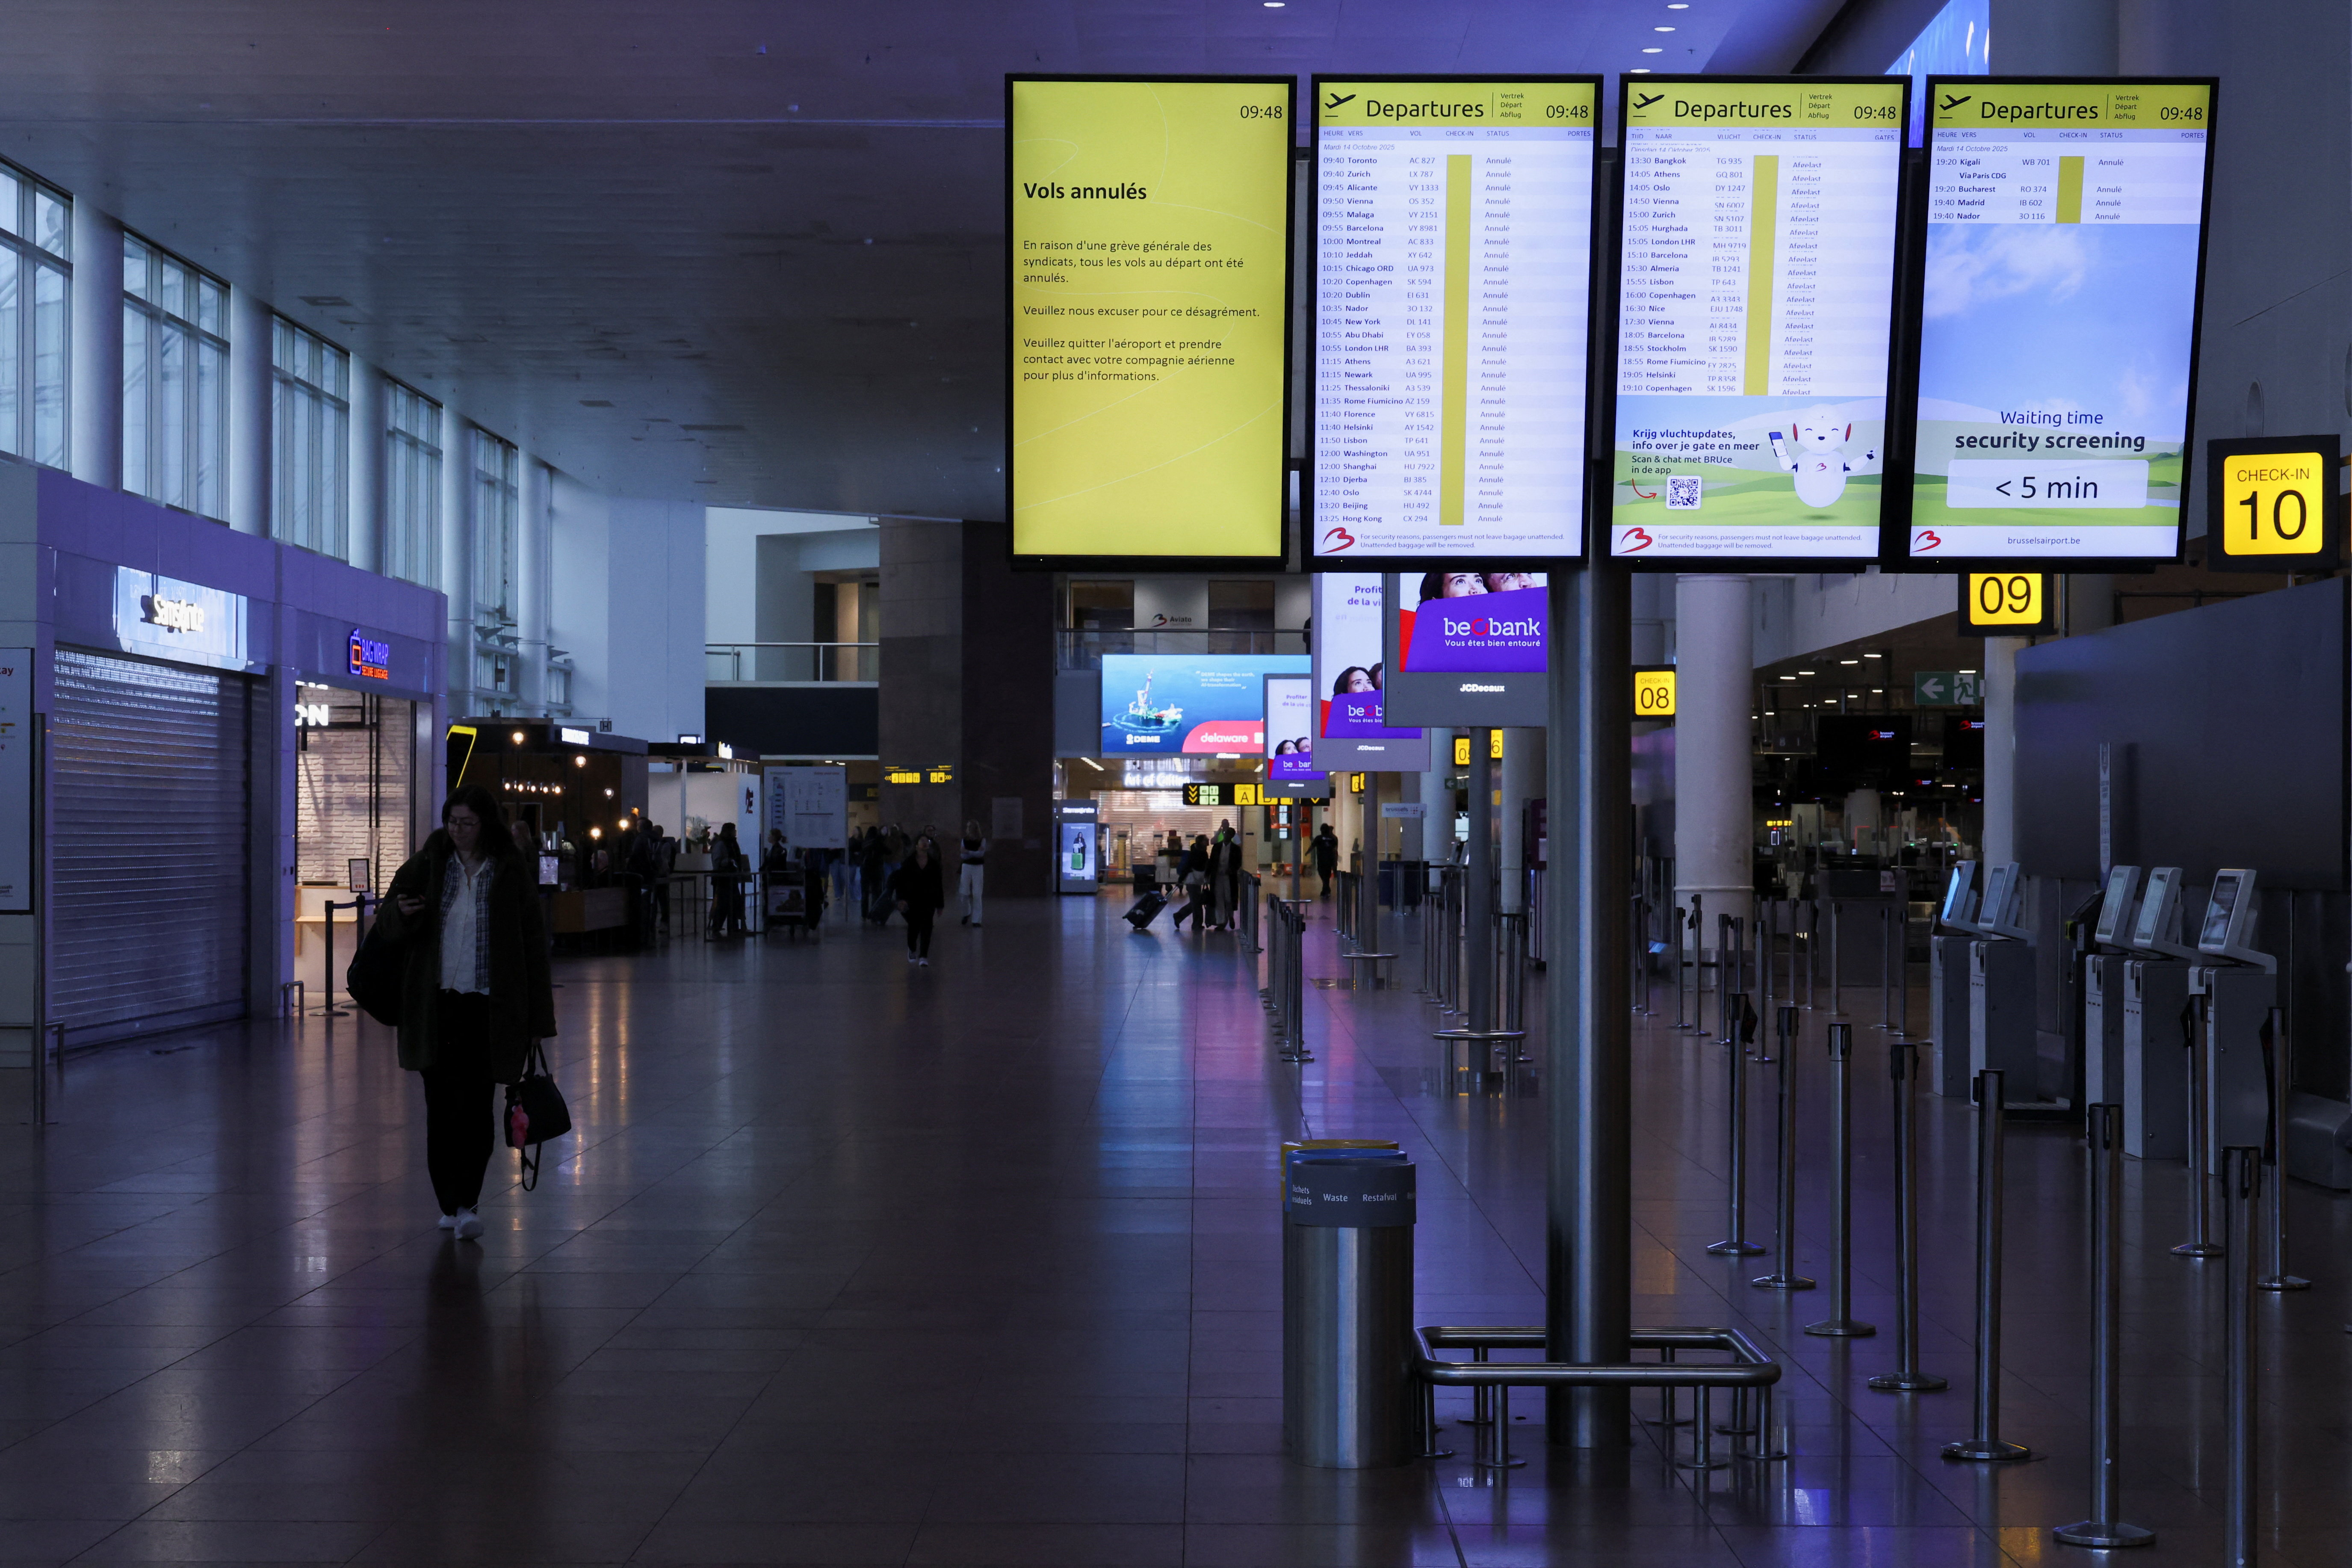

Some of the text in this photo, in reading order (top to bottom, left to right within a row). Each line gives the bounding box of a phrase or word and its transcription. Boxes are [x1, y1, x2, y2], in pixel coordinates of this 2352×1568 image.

[1241, 106, 1282, 118] 09:48
[1367, 100, 1483, 121] Departures
[1546, 105, 1588, 118] 09:48
[1982, 102, 2098, 123] Departures
[2161, 107, 2202, 120] 09:48
[1024, 182, 1146, 199] Vols annulés
[1024, 240, 1211, 253] En raison d'une grève générale des
[1024, 257, 1076, 268] syndicats,
[1080, 258, 1103, 266] tous
[1108, 257, 1121, 266] les
[1125, 257, 1145, 267] vols
[1166, 257, 1201, 269] départ
[1205, 259, 1223, 267] ont
[1226, 258, 1243, 267] été
[1024, 273, 1068, 282] annulés.
[1023, 306, 1065, 315] Veuillez
[1143, 309, 1167, 318] pour
[1186, 307, 1259, 318] désagrément.
[1023, 338, 1221, 350] Veuillez quitter l'aéroport et prendre
[1024, 355, 1064, 363] contact
[1126, 356, 1184, 366] compagnie
[1188, 355, 1235, 365] aérienne
[1024, 370, 1158, 382] pour plus d'informations.
[2001, 411, 2103, 427] Waiting time
[1633, 429, 1735, 440] Krijg vluchtupdates,
[1633, 441, 1652, 449] info
[1680, 441, 1690, 451] je
[1693, 443, 1715, 451] gate
[1955, 431, 2145, 452] security screening
[2237, 468, 2309, 482] CHECK-IN
[2021, 477, 2036, 498] 5
[2048, 476, 2097, 498] min
[2240, 490, 2306, 540] 10
[2008, 537, 2080, 545] brusselsairport.be
[1980, 576, 2031, 614] 09
[361, 638, 389, 665] BAG WRAP
[1460, 684, 1505, 692] JCDecaux
[1641, 687, 1669, 709] 08
[1200, 732, 1248, 743] delaware
[1241, 792, 1249, 803] A
[1323, 1193, 1347, 1202] Waste
[1363, 1193, 1396, 1202] Restafval
